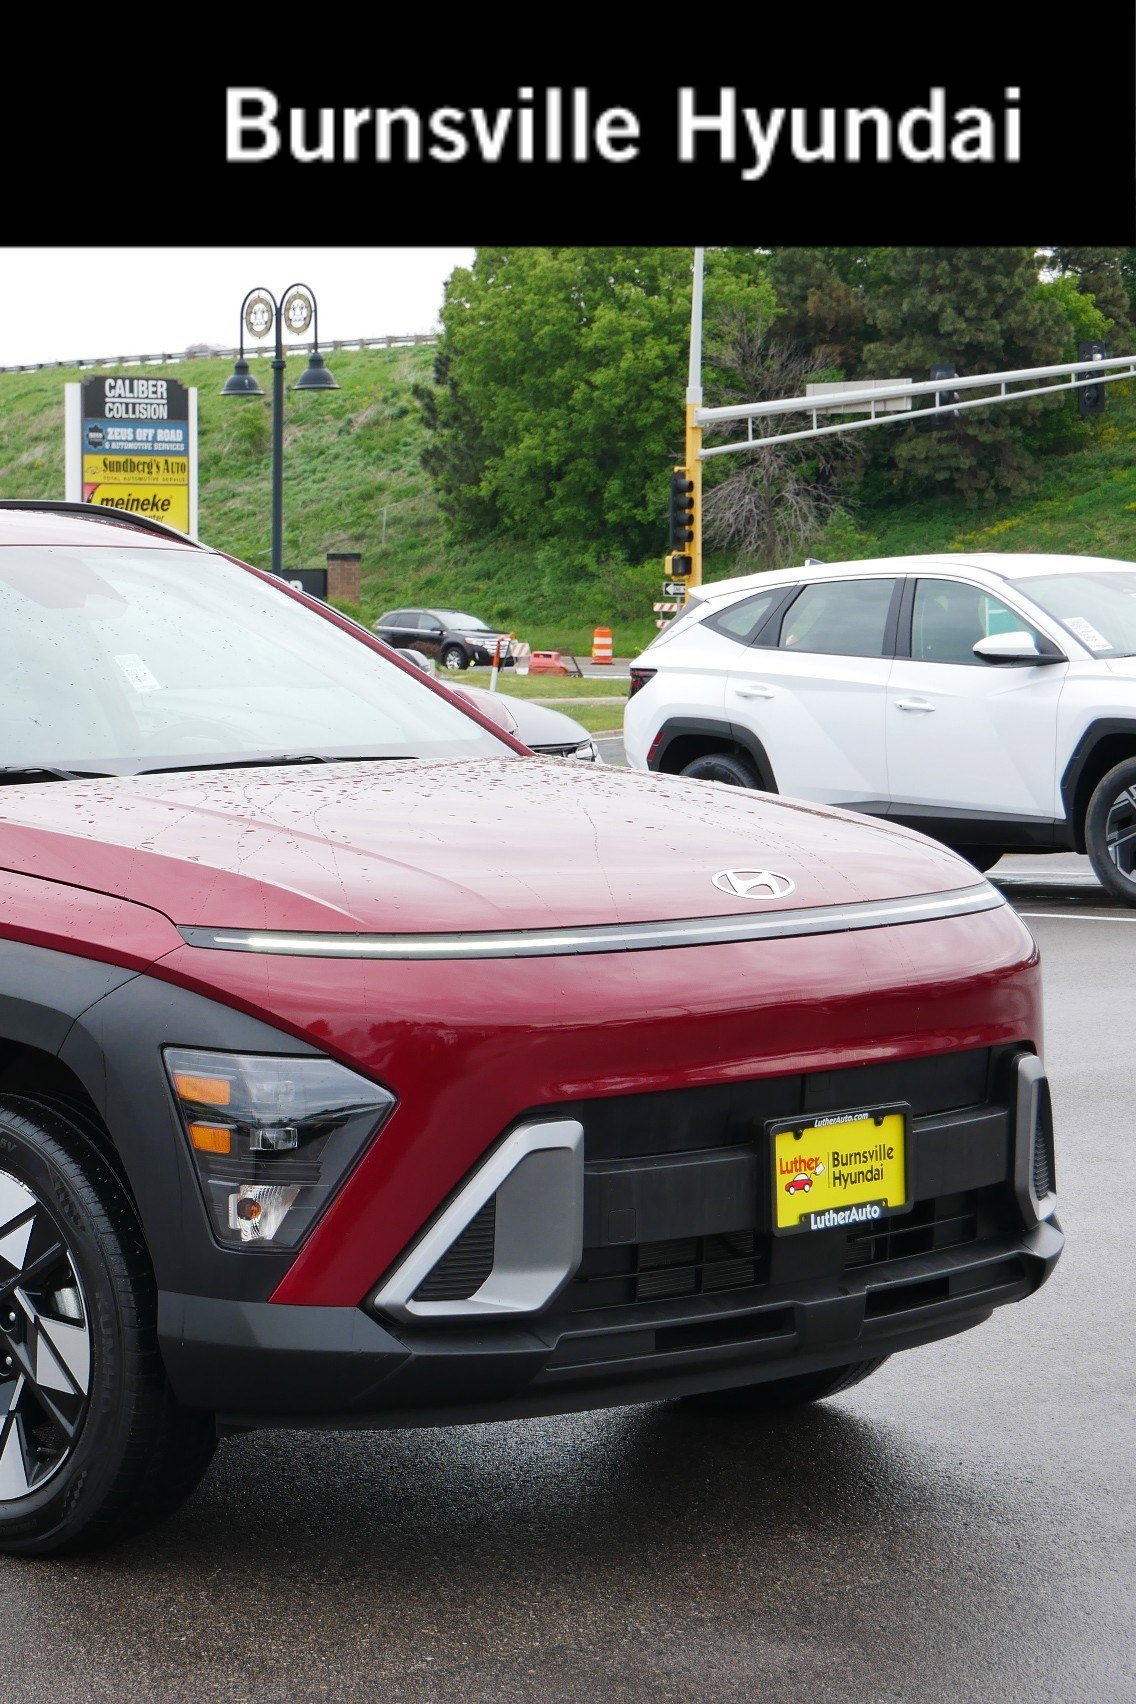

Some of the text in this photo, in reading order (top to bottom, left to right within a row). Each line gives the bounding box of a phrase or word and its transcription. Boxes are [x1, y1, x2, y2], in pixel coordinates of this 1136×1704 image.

[105, 378, 168, 399] CALIBER
[105, 402, 168, 420] COLLISION
[107, 427, 134, 441] ZEUS
[135, 428, 155, 442] OFF
[156, 429, 183, 442] ROAD
[111, 441, 153, 450] AUTOMOTIVE
[153, 442, 185, 451] SERVICES
[102, 457, 161, 475] Sundberg's
[101, 494, 171, 512] meineke
[814, 1112, 869, 1128] LutherAuto.com
[831, 1143, 895, 1169] Burnsville
[779, 1155, 821, 1176] Luther
[832, 1163, 884, 1190] Hyundai
[810, 1204, 880, 1230] LutherAuto
